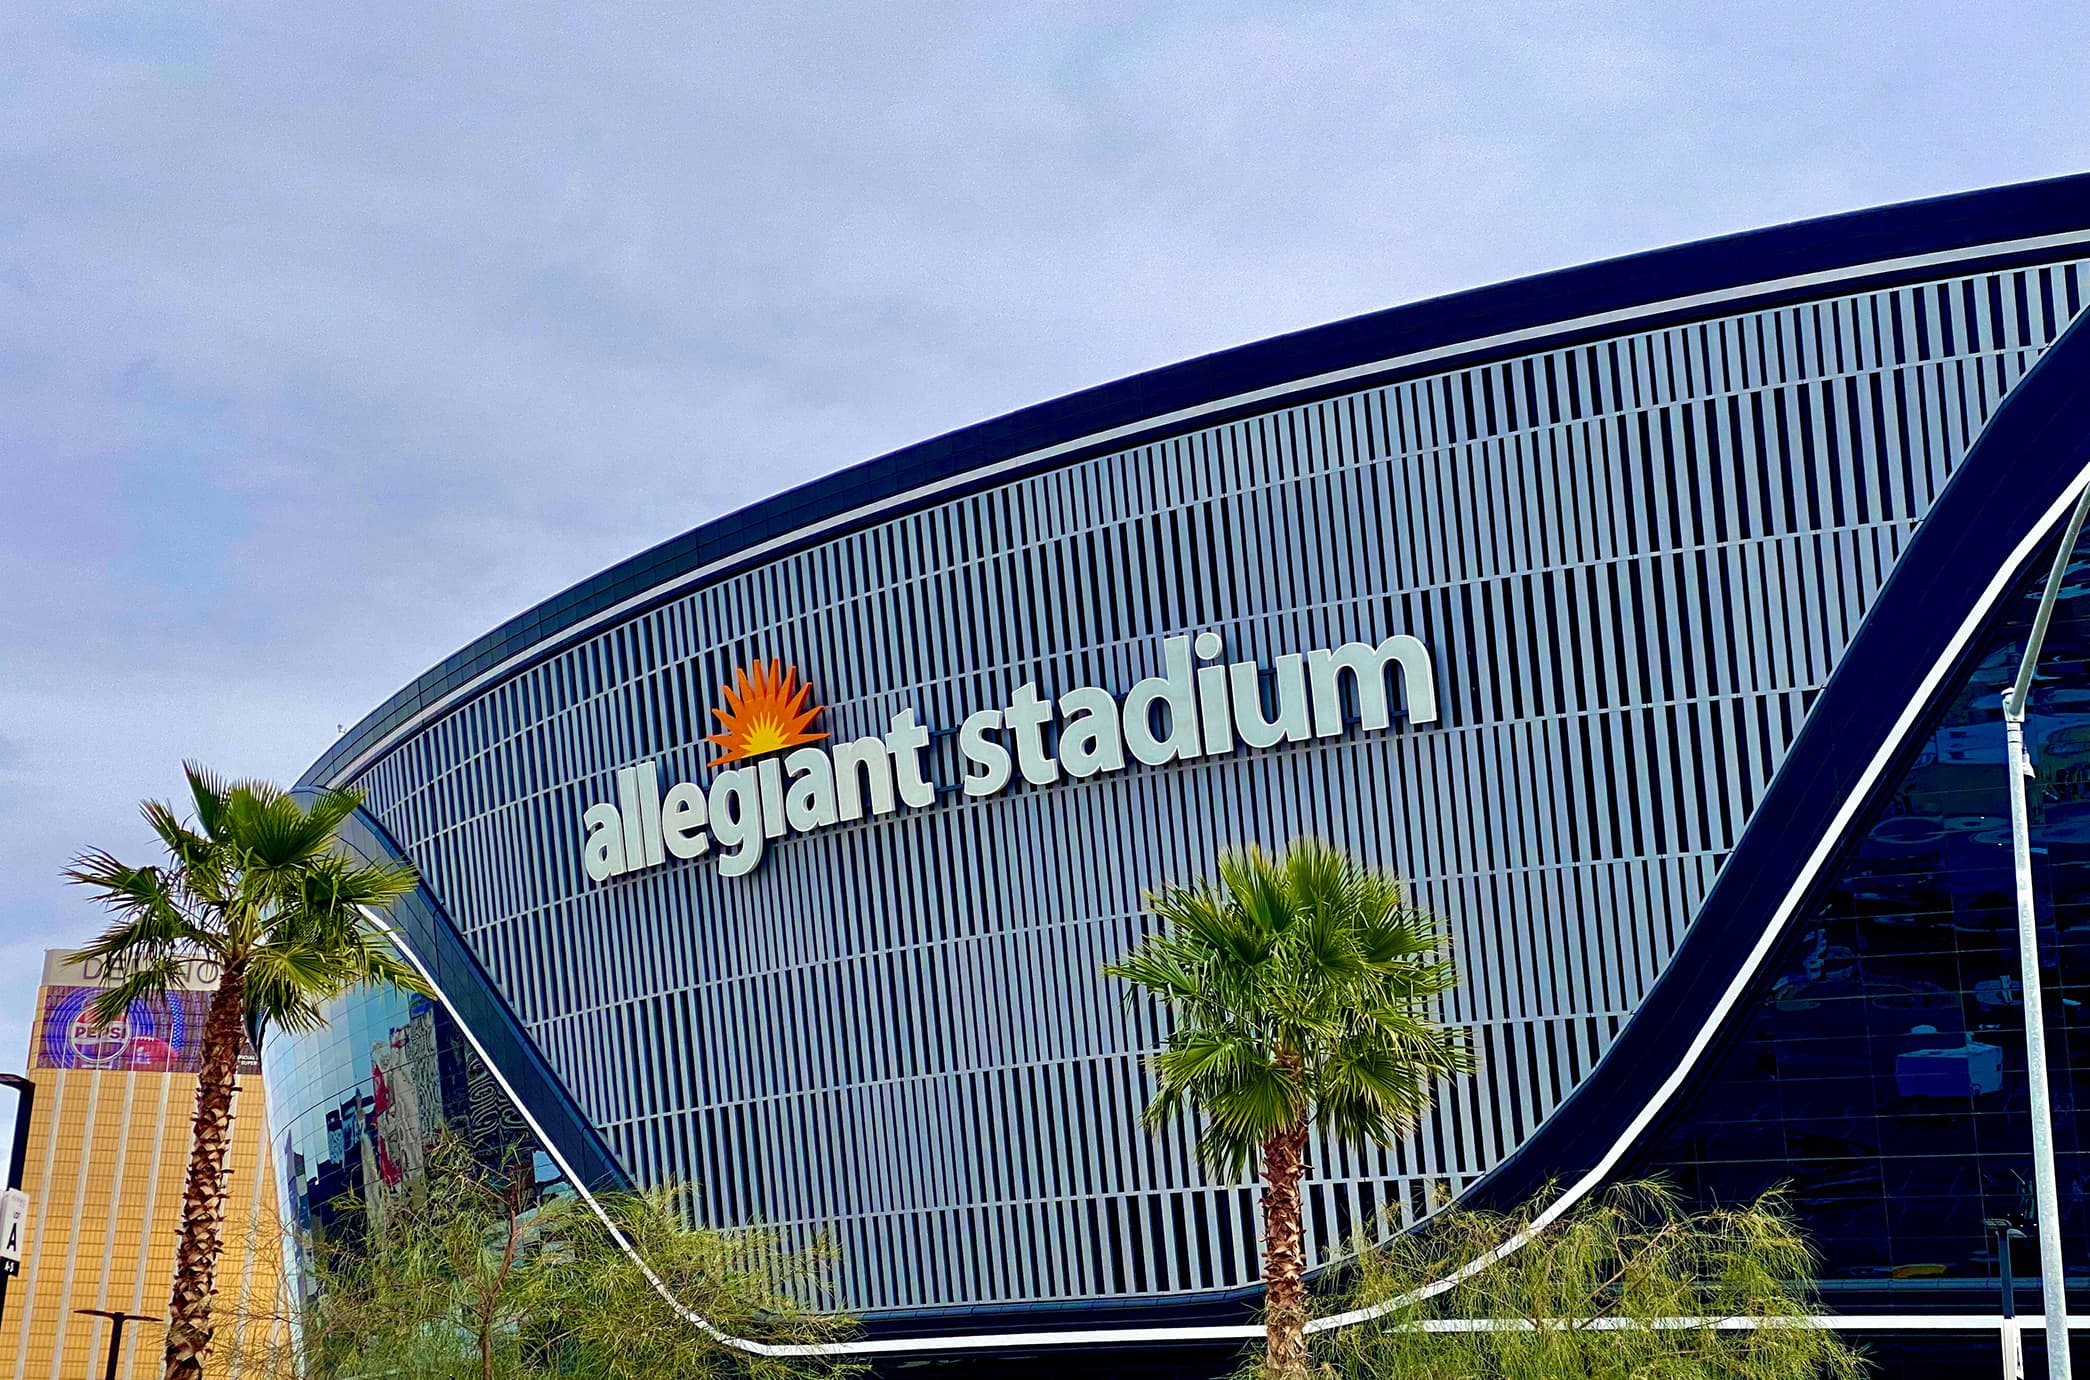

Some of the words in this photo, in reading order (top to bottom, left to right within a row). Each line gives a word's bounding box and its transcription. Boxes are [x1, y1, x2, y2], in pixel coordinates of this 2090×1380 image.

[583, 706, 935, 881] allegiant
[959, 632, 1438, 796] stadium
[6, 1222, 17, 1252] A
